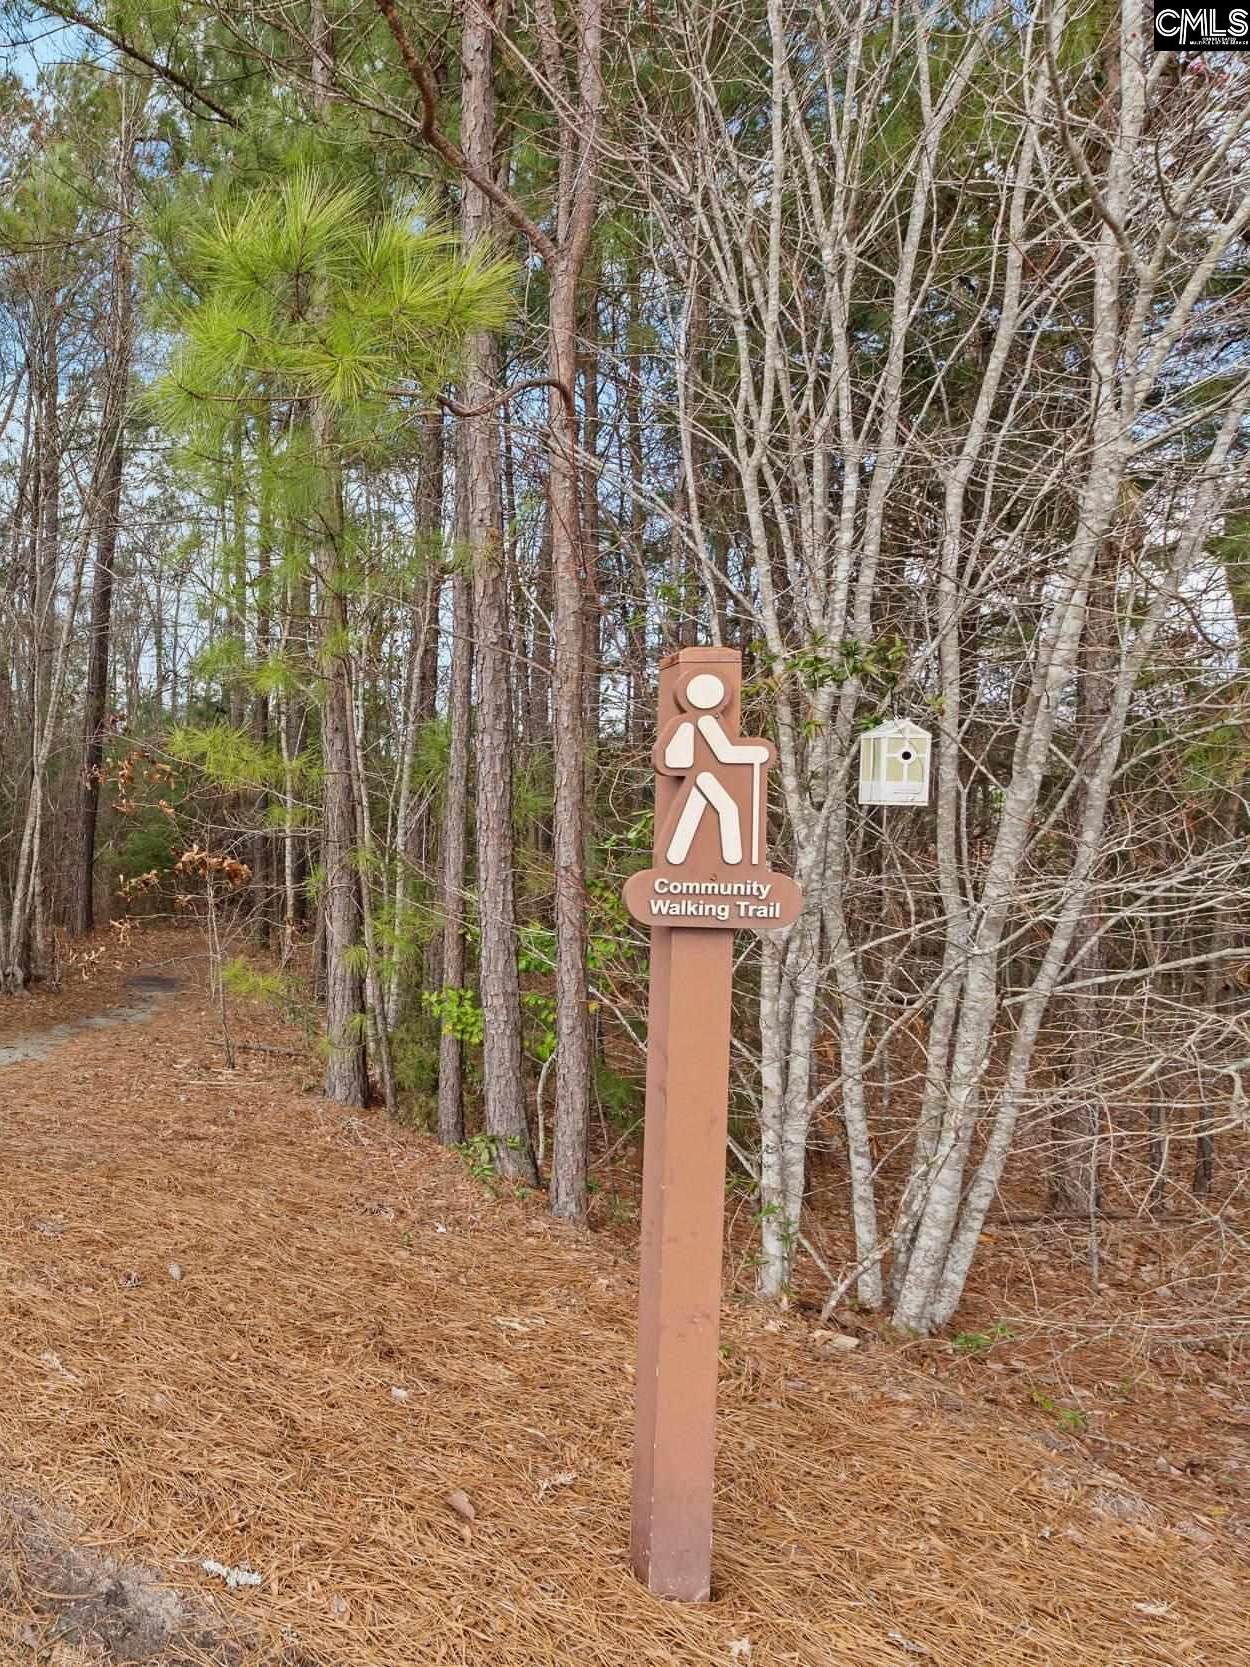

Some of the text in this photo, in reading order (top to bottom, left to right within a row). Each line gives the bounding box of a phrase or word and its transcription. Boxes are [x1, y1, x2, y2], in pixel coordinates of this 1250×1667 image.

[654, 878, 772, 900] Community
[649, 899, 782, 920] Walking Trail
